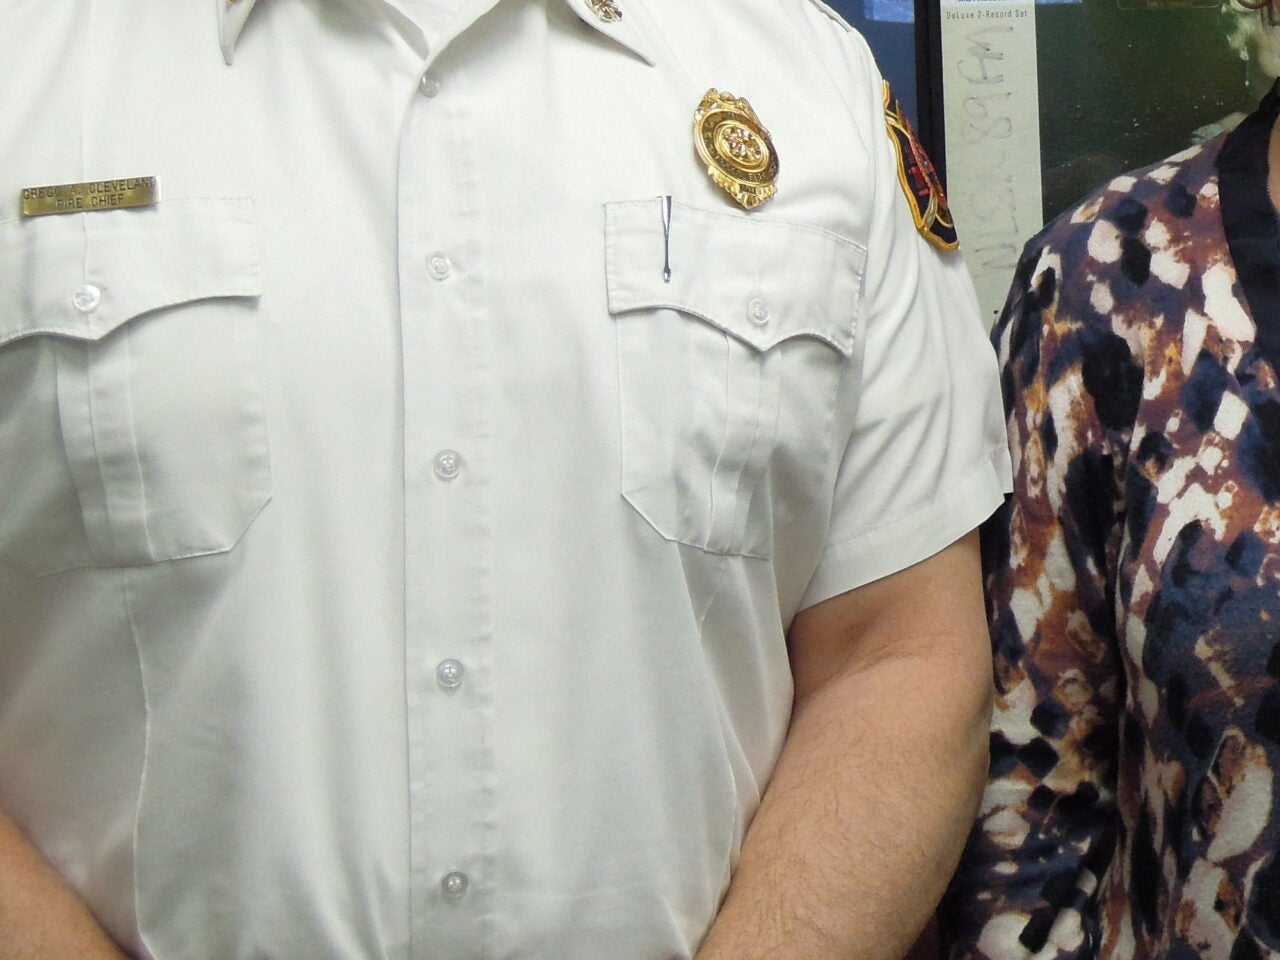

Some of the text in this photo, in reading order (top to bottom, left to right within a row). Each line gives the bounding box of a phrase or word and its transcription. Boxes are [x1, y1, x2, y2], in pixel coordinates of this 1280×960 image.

[946, 10, 974, 19] DeLuxe
[57, 193, 124, 209] FIRE CHIEF
